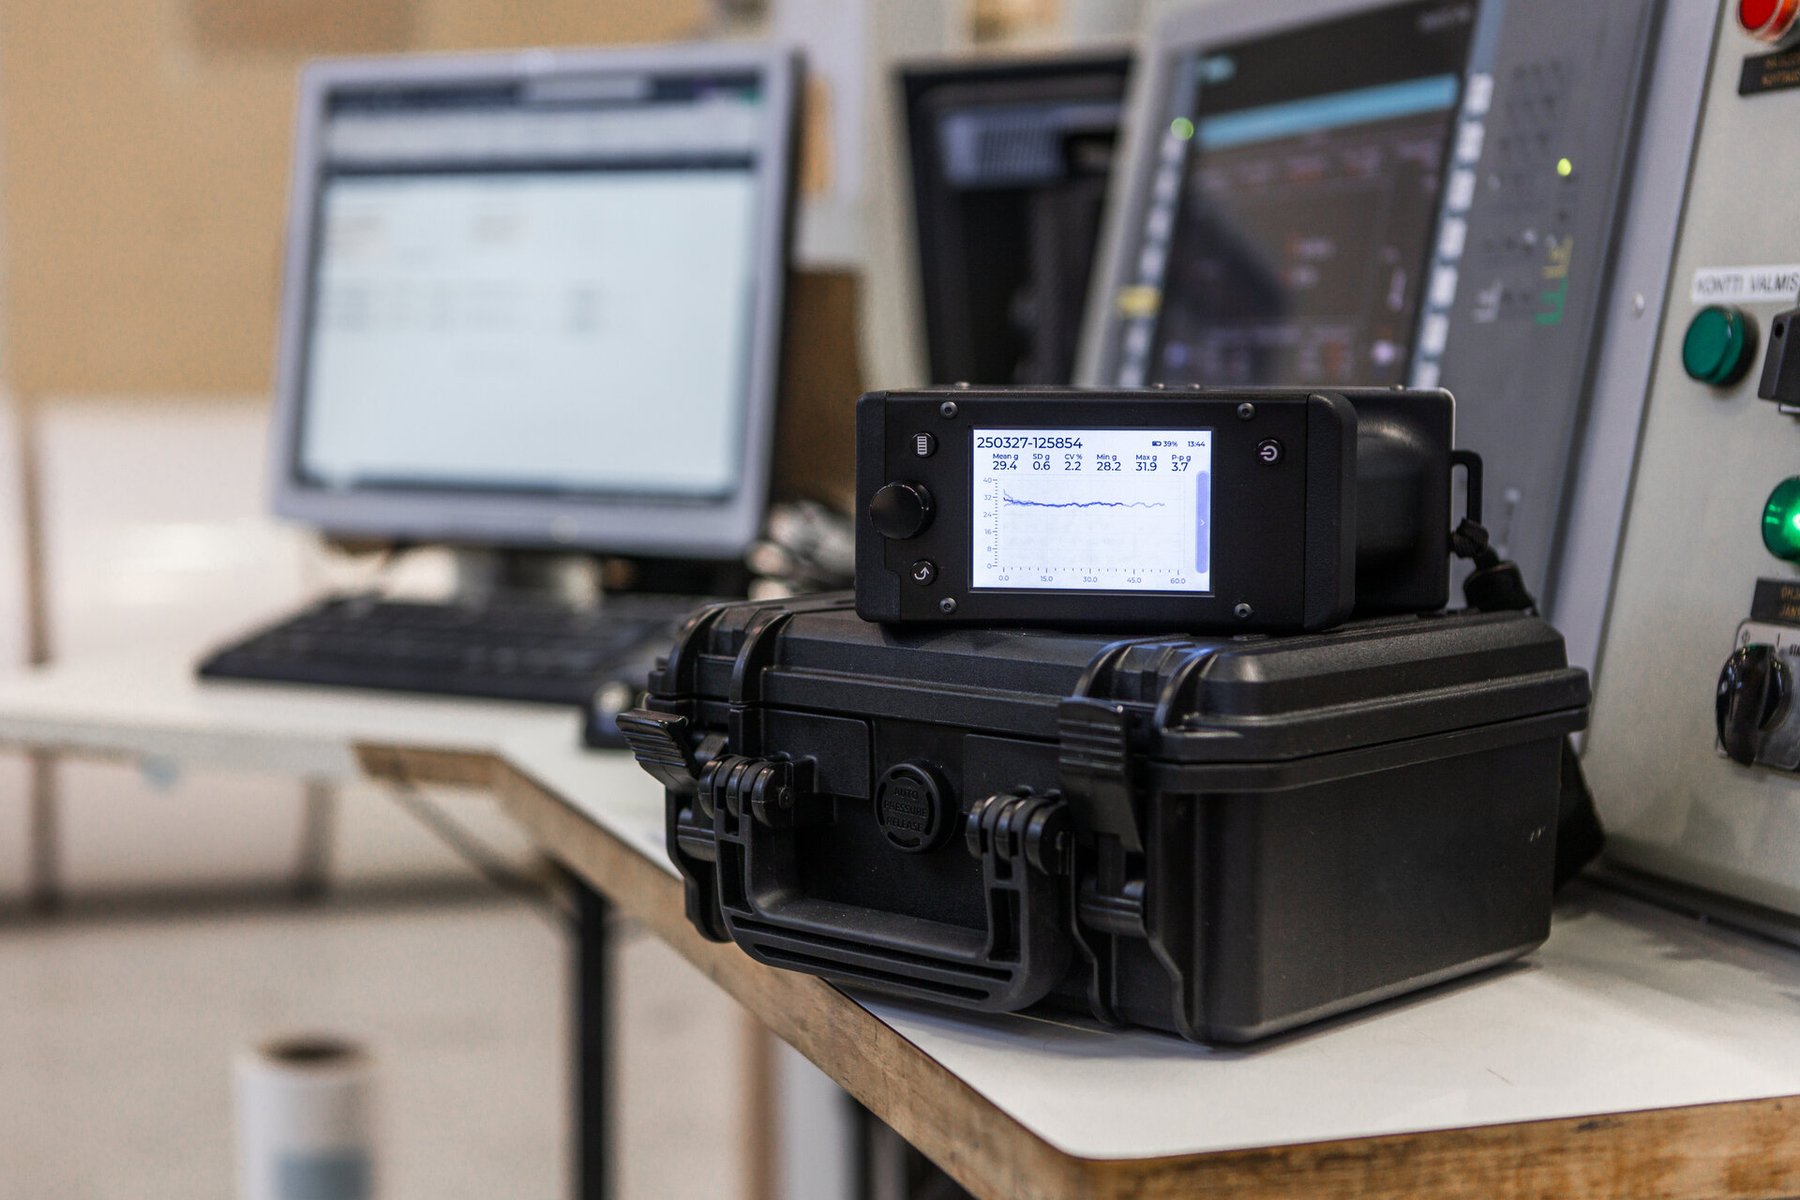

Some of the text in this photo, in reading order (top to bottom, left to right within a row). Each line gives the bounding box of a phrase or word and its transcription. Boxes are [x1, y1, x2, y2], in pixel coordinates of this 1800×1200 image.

[1751, 271, 1800, 292] VALMIS
[976, 436, 1083, 449] 250327-125854
[992, 460, 1017, 470] 29.4
[1032, 461, 1050, 471] 0.6
[1064, 461, 1081, 471] 2.2
[1096, 461, 1122, 471] 28.2
[1135, 461, 1157, 472] 31.9
[1171, 462, 1188, 472] 3.7
[894, 786, 918, 799] AUTO
[884, 800, 928, 817] PRESSURE
[886, 816, 923, 832] RELEASE
